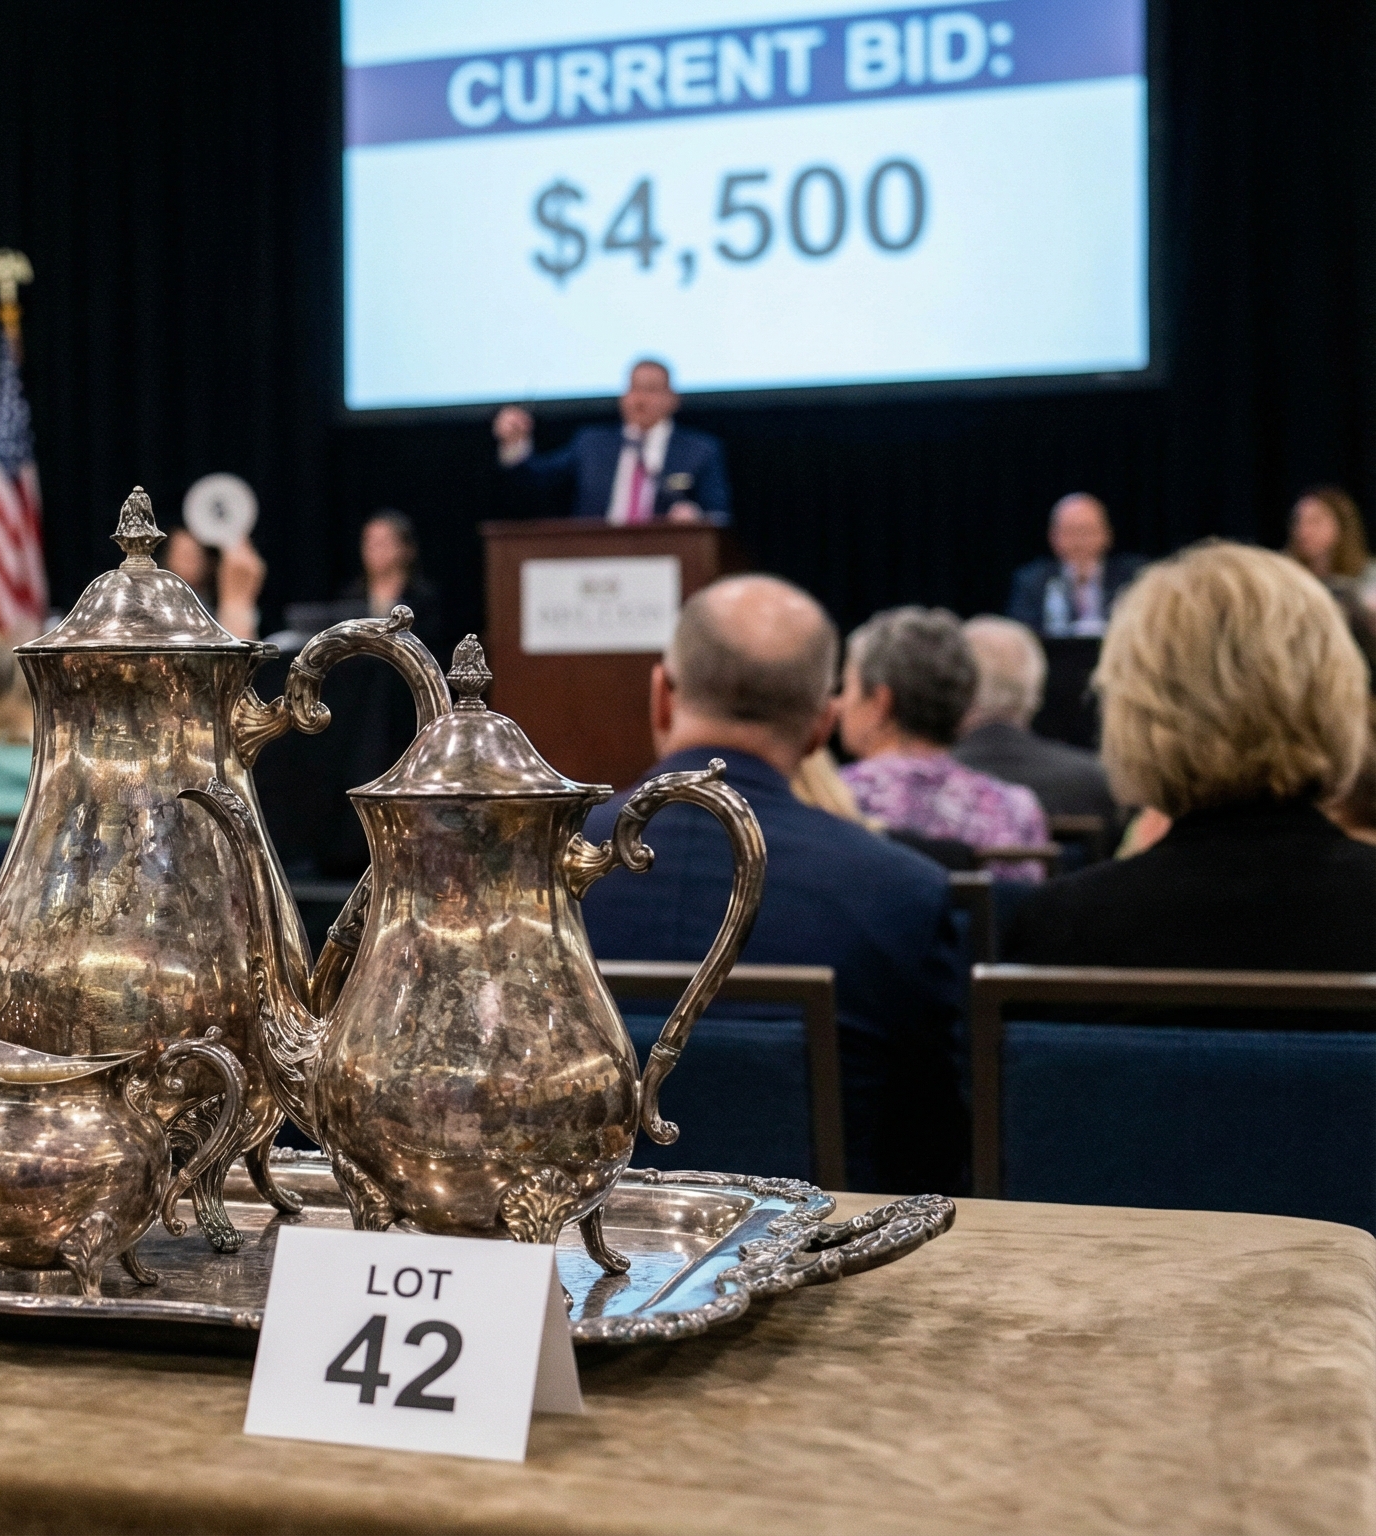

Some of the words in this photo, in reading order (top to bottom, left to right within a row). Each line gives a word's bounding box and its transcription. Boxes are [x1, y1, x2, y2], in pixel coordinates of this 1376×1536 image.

[447, 27, 826, 128] CURRENT
[844, 10, 1014, 92] BID:
[532, 157, 927, 285] $4,500
[367, 1264, 452, 1300] LOT
[325, 1314, 463, 1412] 42
